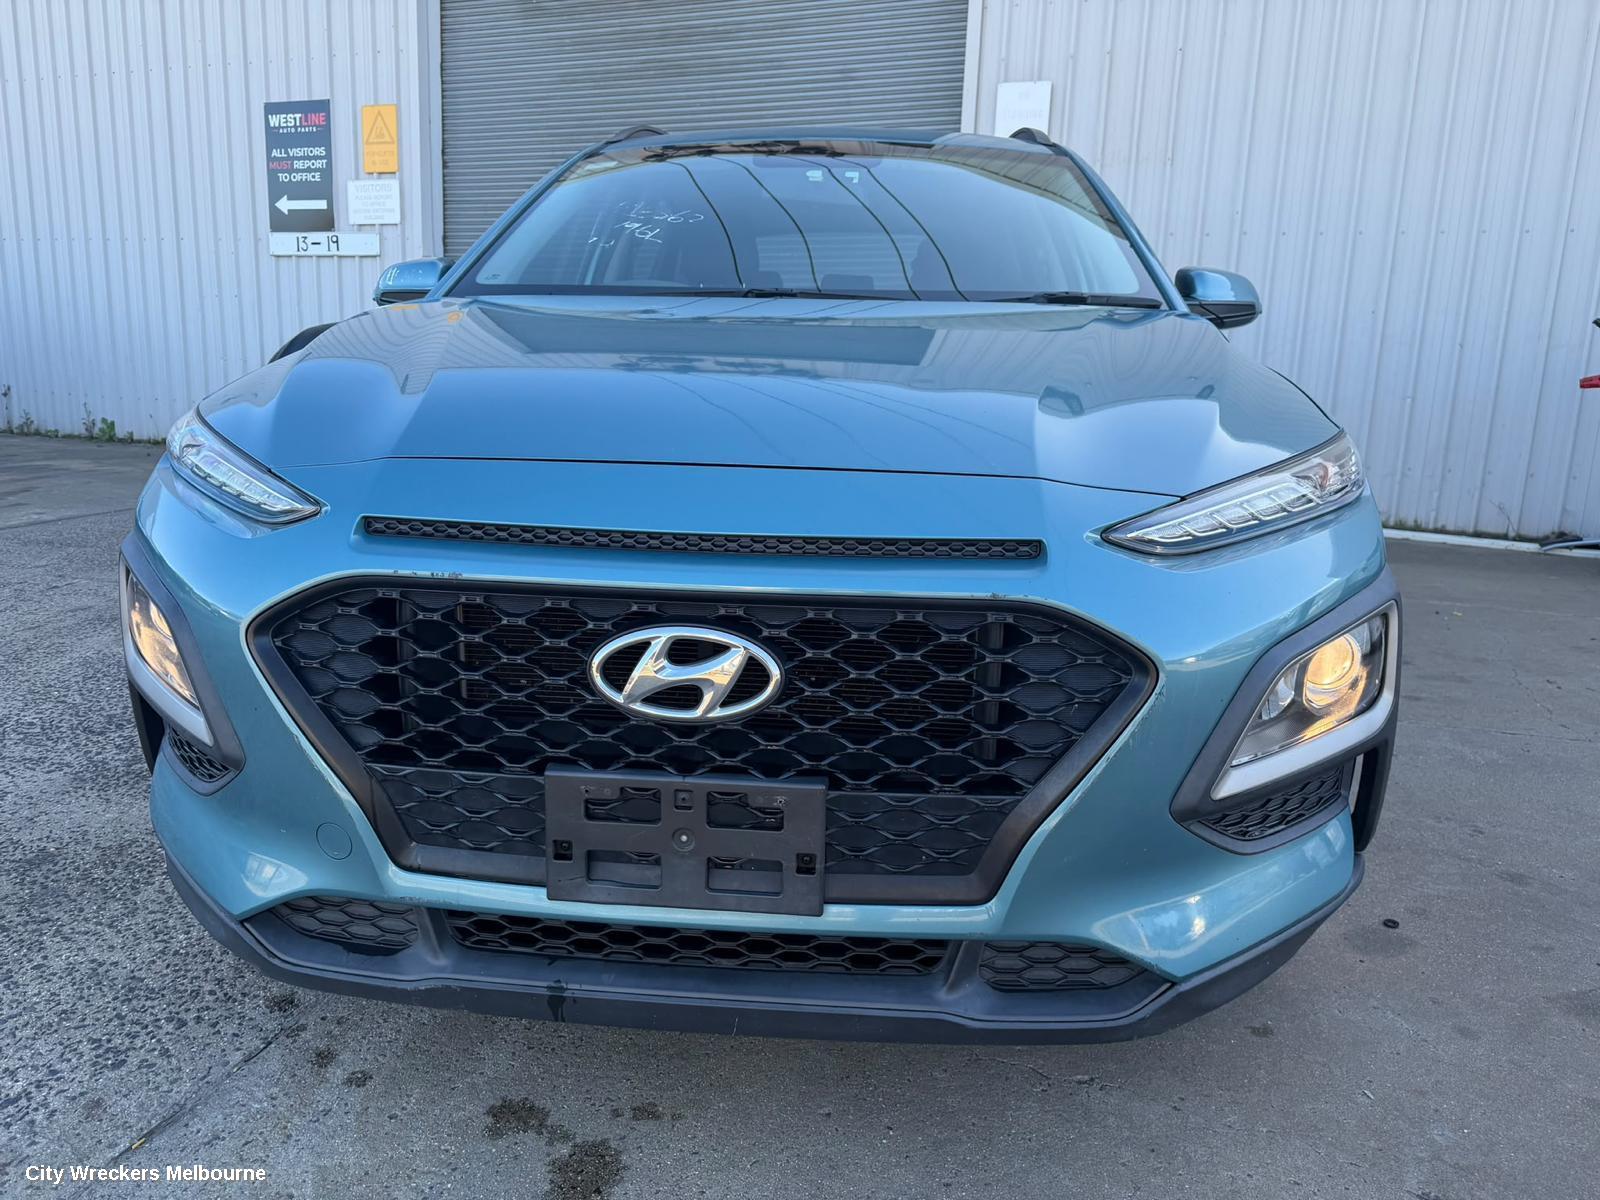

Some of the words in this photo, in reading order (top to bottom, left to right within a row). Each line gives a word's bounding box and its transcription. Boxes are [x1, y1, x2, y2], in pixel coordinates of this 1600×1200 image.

[268, 112, 327, 127] WESTLINE
[271, 148, 287, 158] ALL
[288, 147, 326, 157] VISITORS
[269, 160, 292, 170] MUST
[293, 159, 328, 169] REPORT
[277, 173, 290, 182] TO
[291, 172, 321, 182] OFFICE
